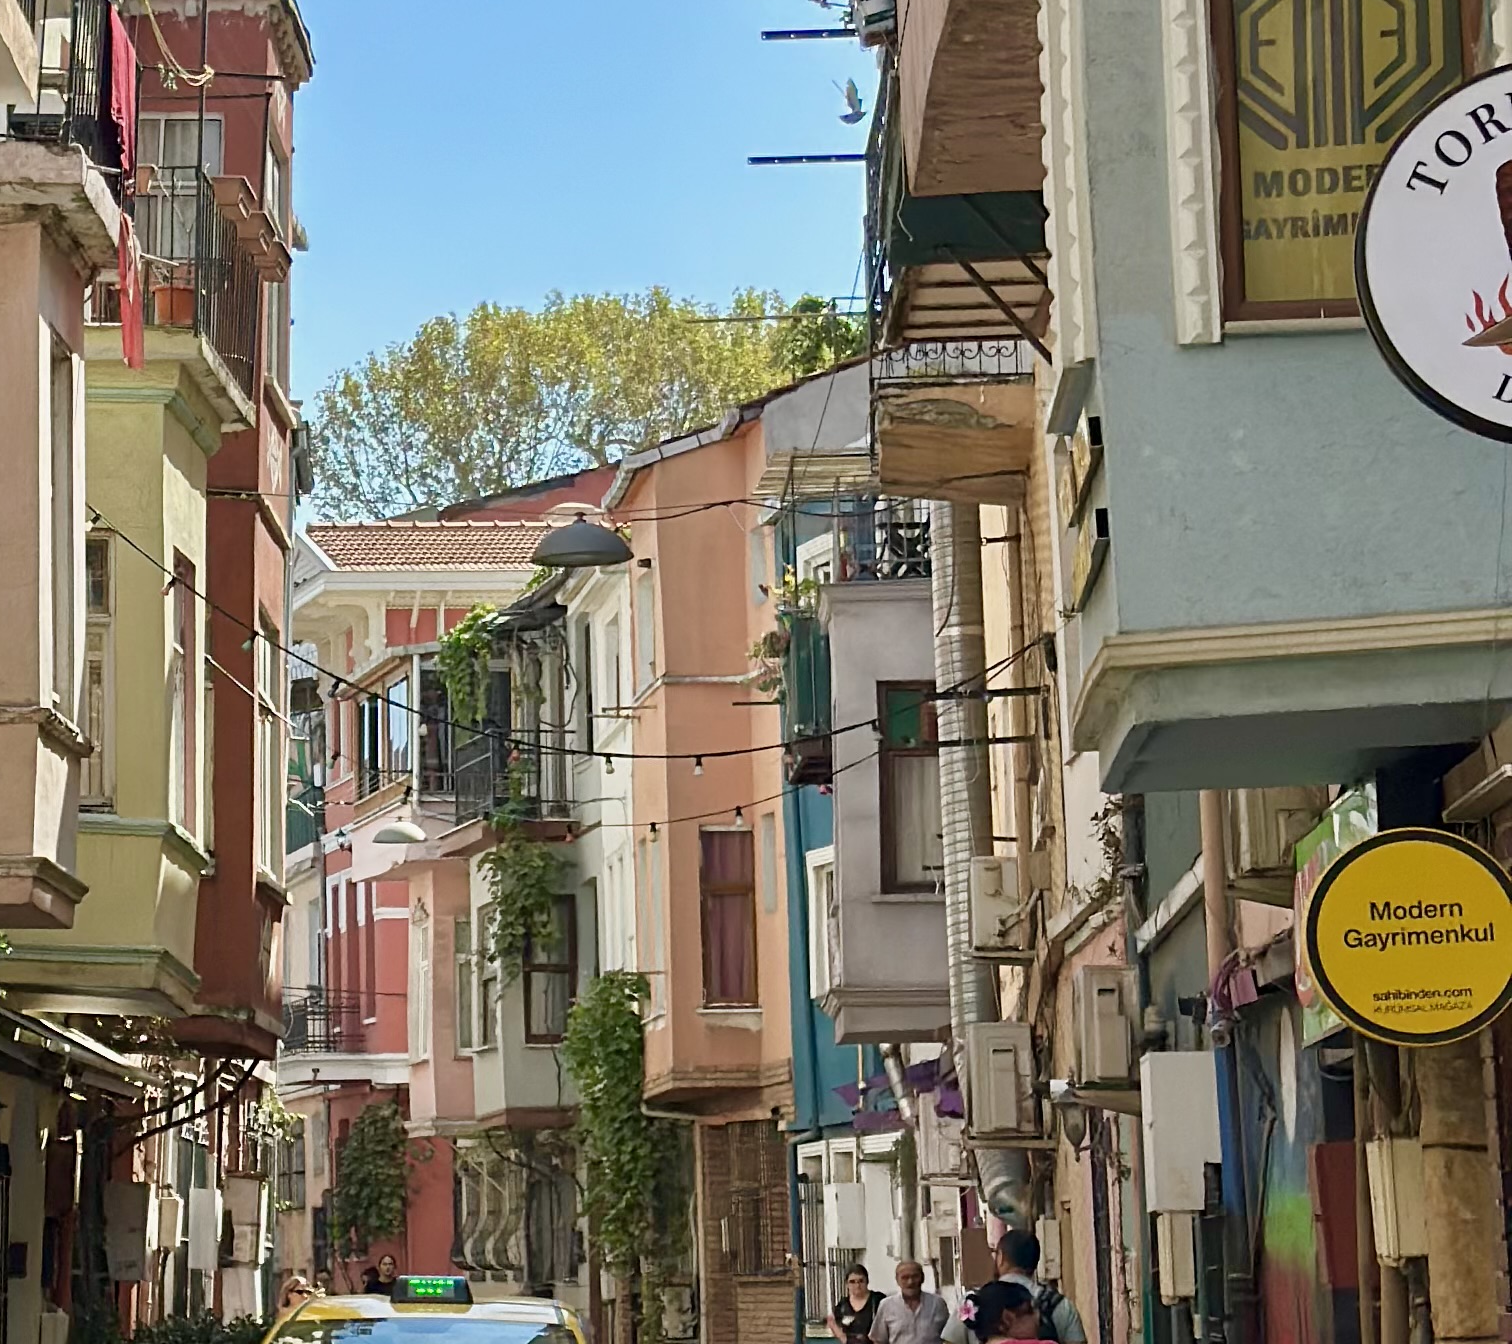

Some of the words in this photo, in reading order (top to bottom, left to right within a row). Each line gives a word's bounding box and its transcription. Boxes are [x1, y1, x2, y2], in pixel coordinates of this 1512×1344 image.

[1406, 92, 1512, 196] TOR
[1369, 900, 1463, 921] Modern
[1343, 922, 1495, 952] Gayrimenkul
[1372, 987, 1473, 1002] sahibinden.com
